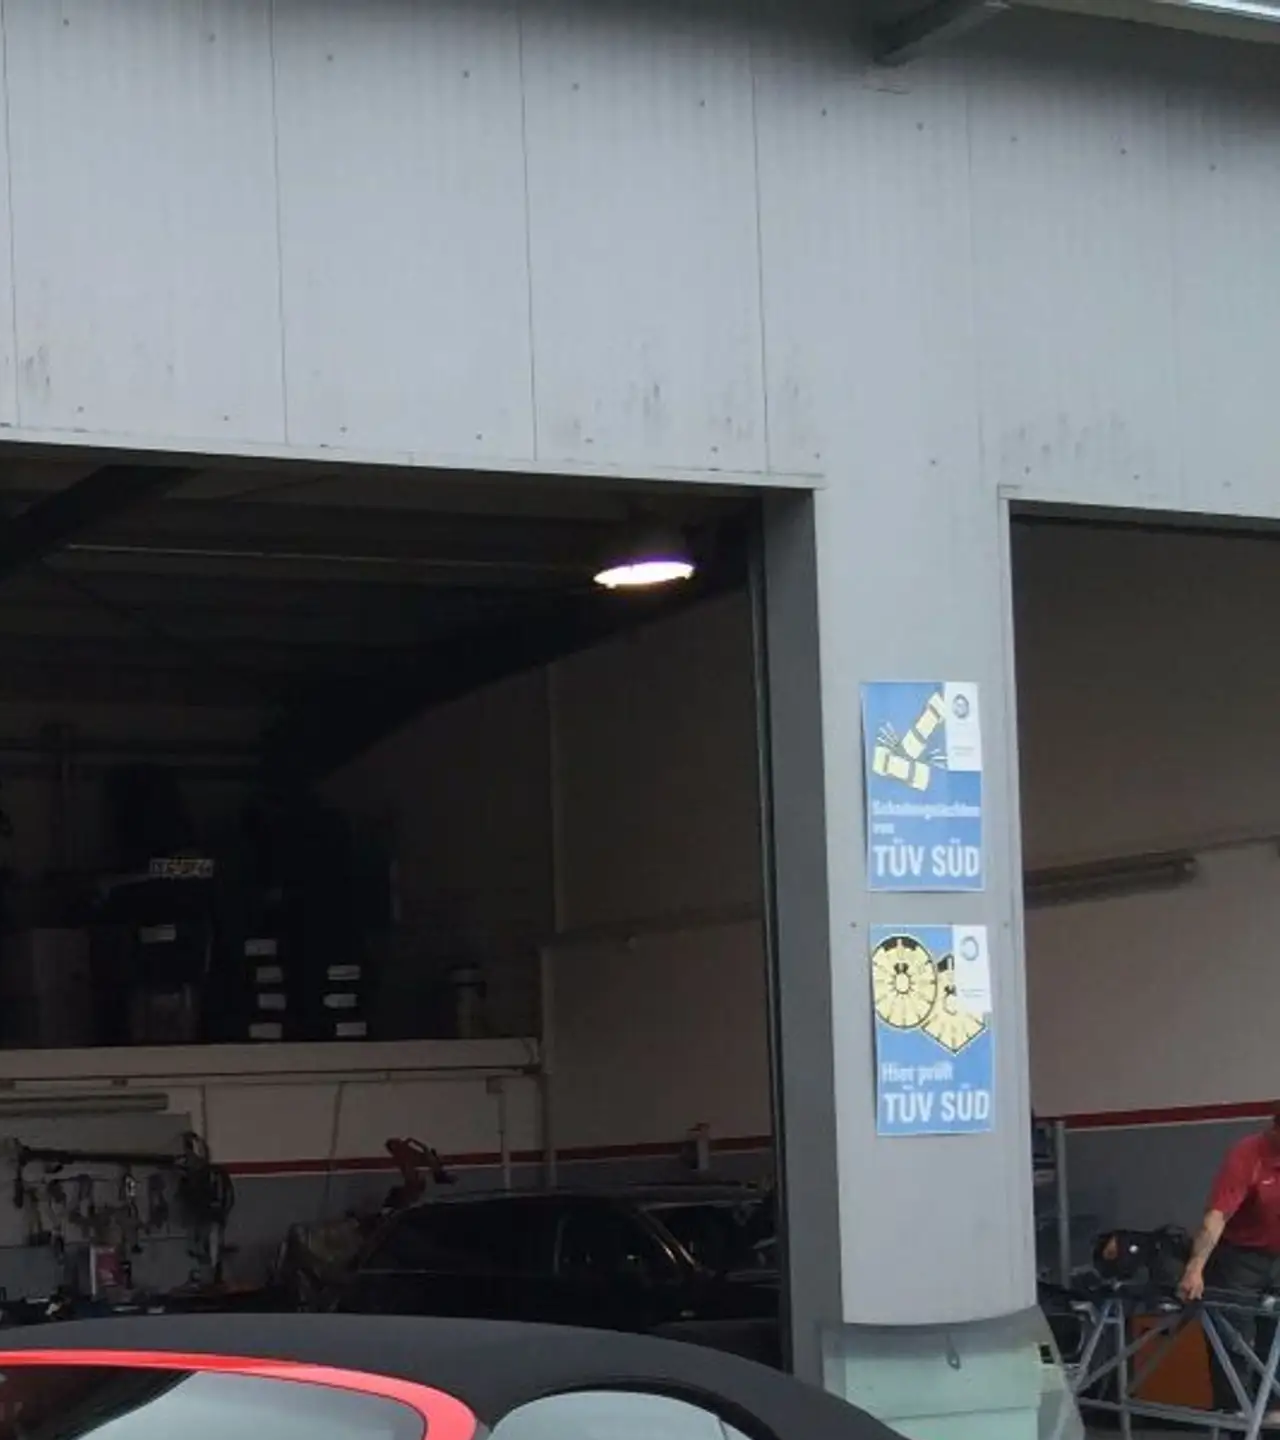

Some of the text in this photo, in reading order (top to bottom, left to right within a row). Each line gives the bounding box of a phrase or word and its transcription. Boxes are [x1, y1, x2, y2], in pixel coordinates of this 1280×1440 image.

[872, 837, 980, 878] TÜV SÜD
[883, 1083, 990, 1124] TÜV SÜD
